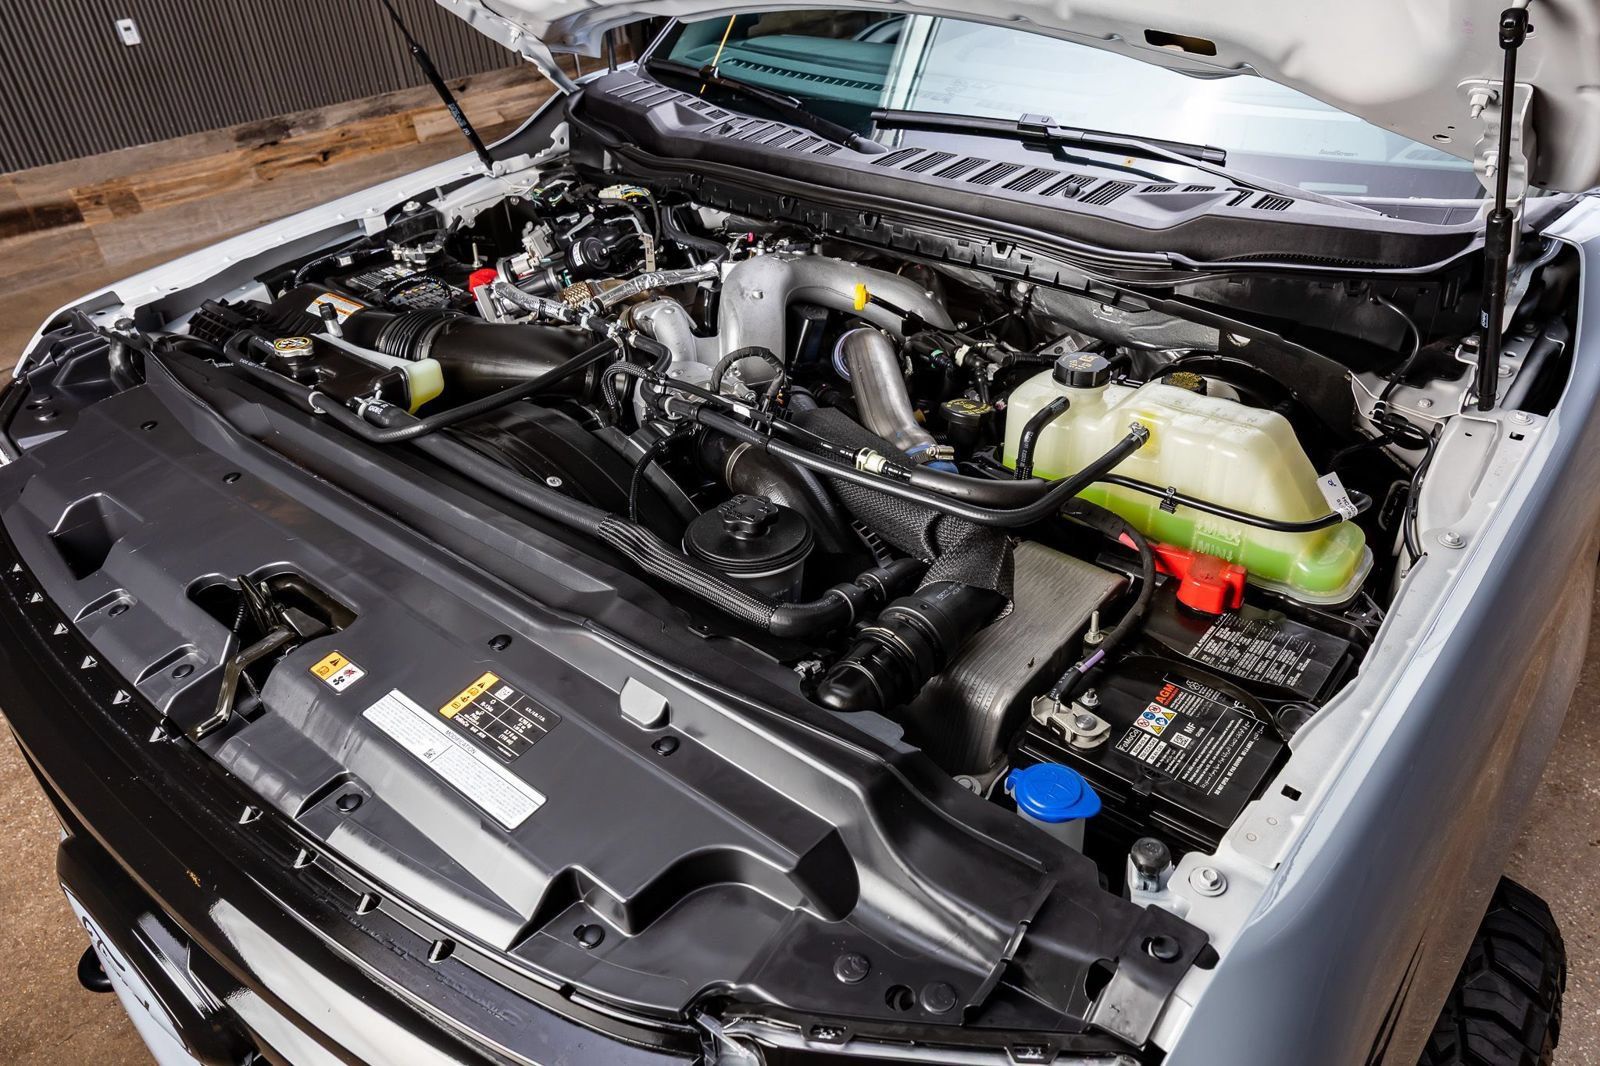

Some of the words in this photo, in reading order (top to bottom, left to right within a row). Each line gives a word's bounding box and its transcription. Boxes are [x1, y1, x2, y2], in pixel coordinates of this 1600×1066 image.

[1155, 683, 1175, 703] AGM
[1184, 722, 1196, 734] MF
[445, 729, 477, 755] MODIFICATION
[1118, 728, 1140, 752] FoMoCo
